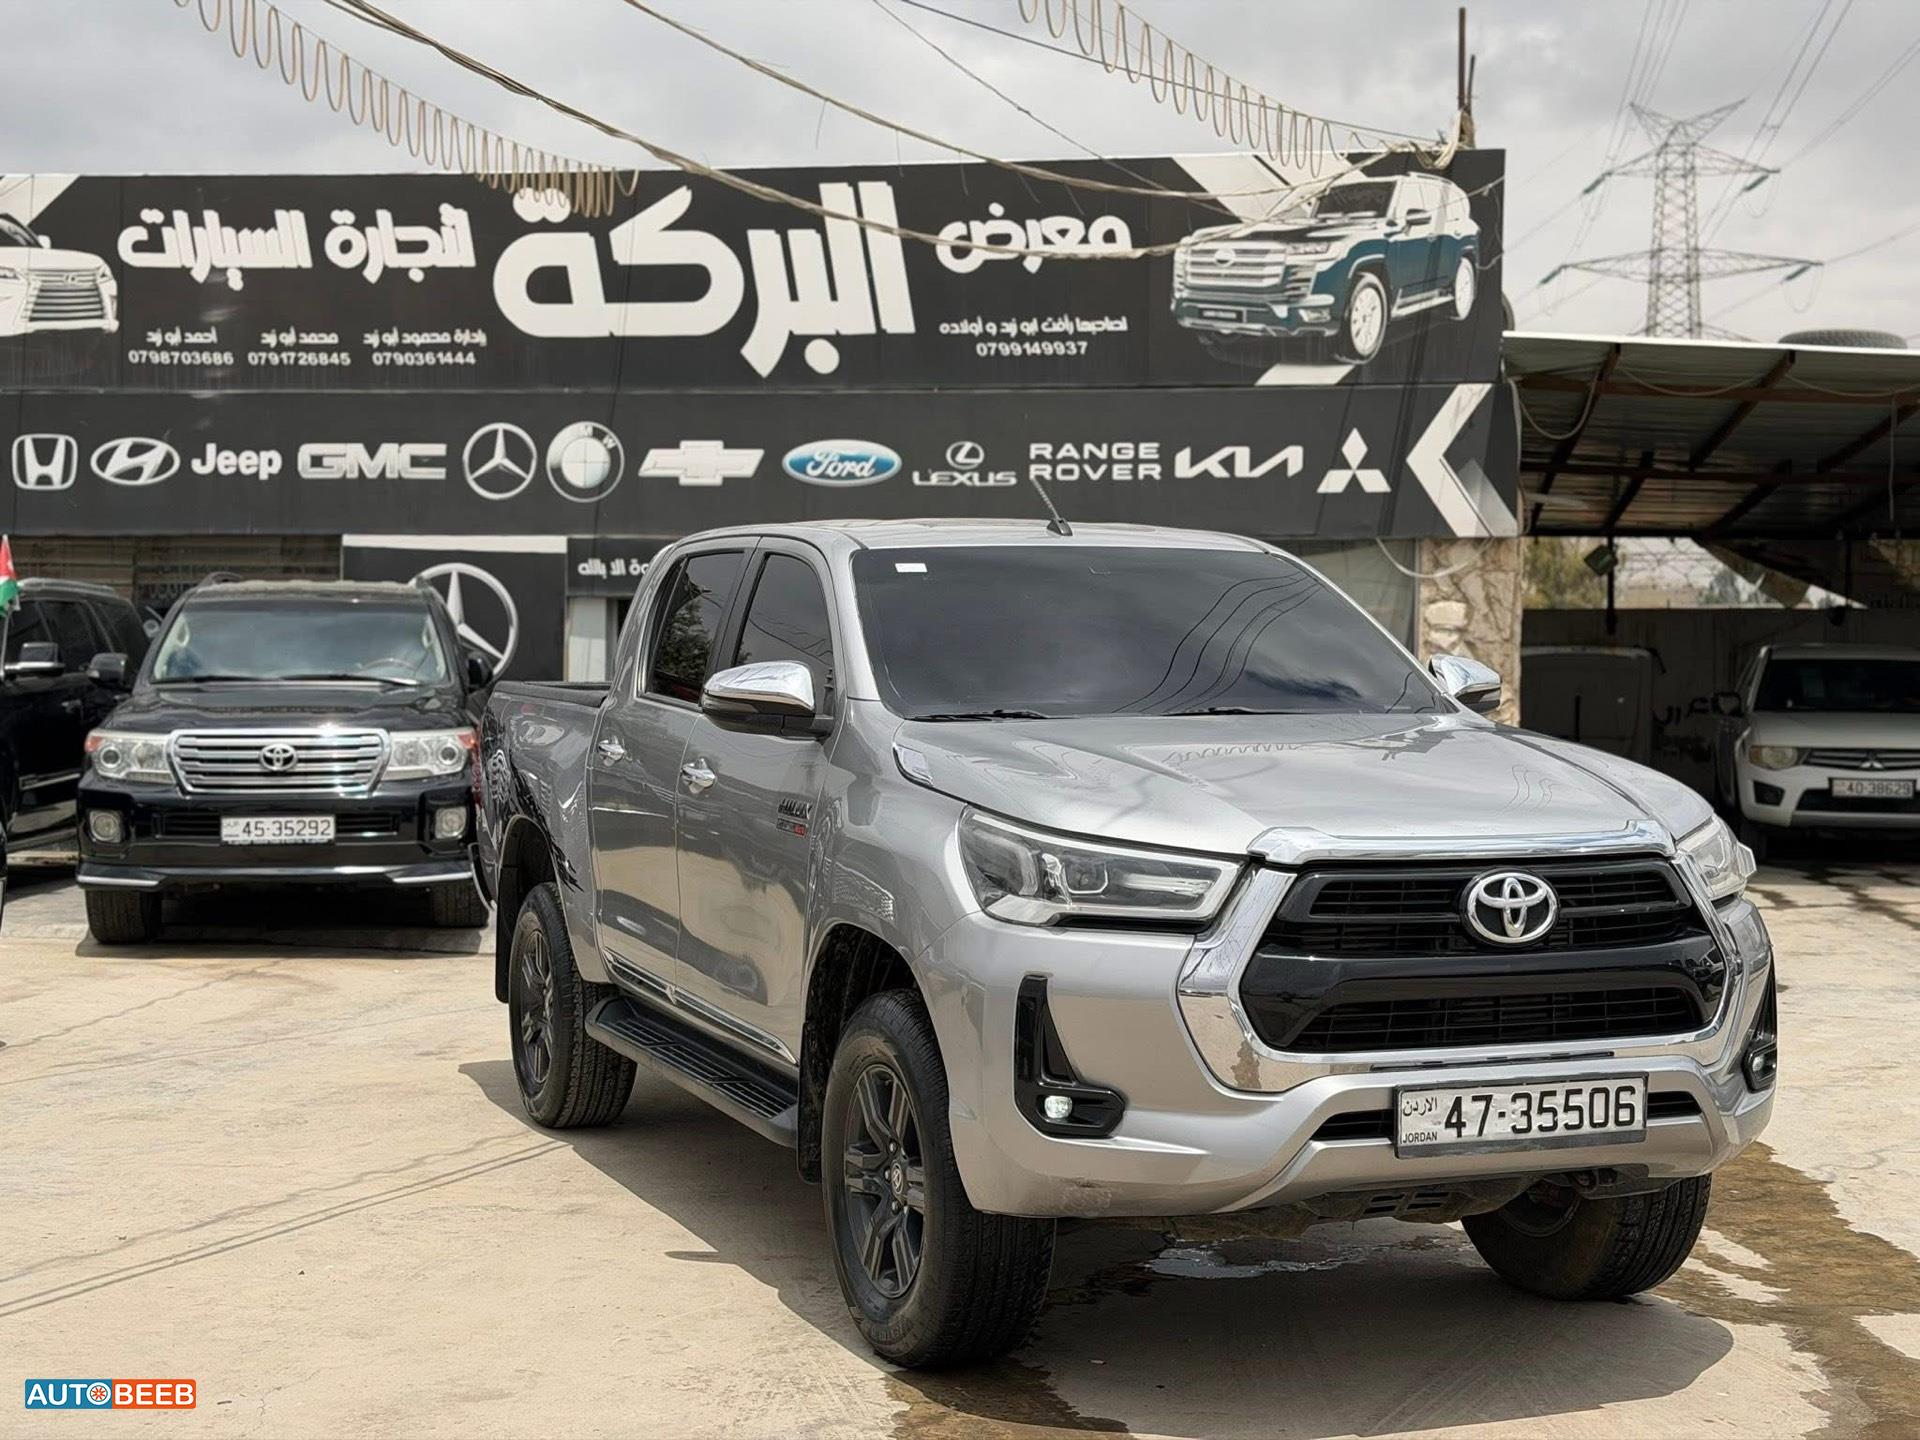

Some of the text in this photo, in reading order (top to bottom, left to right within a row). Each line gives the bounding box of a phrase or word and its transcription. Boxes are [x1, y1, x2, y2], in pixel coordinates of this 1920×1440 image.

[116, 181, 1134, 378] معرض البركة لتجارة السيارات
[299, 333, 338, 344] محمد
[402, 332, 451, 346] محمود
[976, 341, 1087, 356] 0799149937
[128, 350, 233, 365] 0798703686
[248, 352, 351, 365] 0791726845
[372, 352, 476, 365] 0790361444
[1030, 443, 1159, 459] RANGE
[192, 443, 282, 480] Jeep
[297, 441, 448, 481] GMC
[805, 449, 876, 478] Ford
[1175, 446, 1303, 478] KIA
[913, 467, 1017, 486] LEXUS
[1030, 464, 1161, 481] ROVER
[242, 820, 331, 837] 45-35292
[1445, 1086, 1636, 1138] 47-35506
[1402, 1132, 1437, 1144] JORDAN
